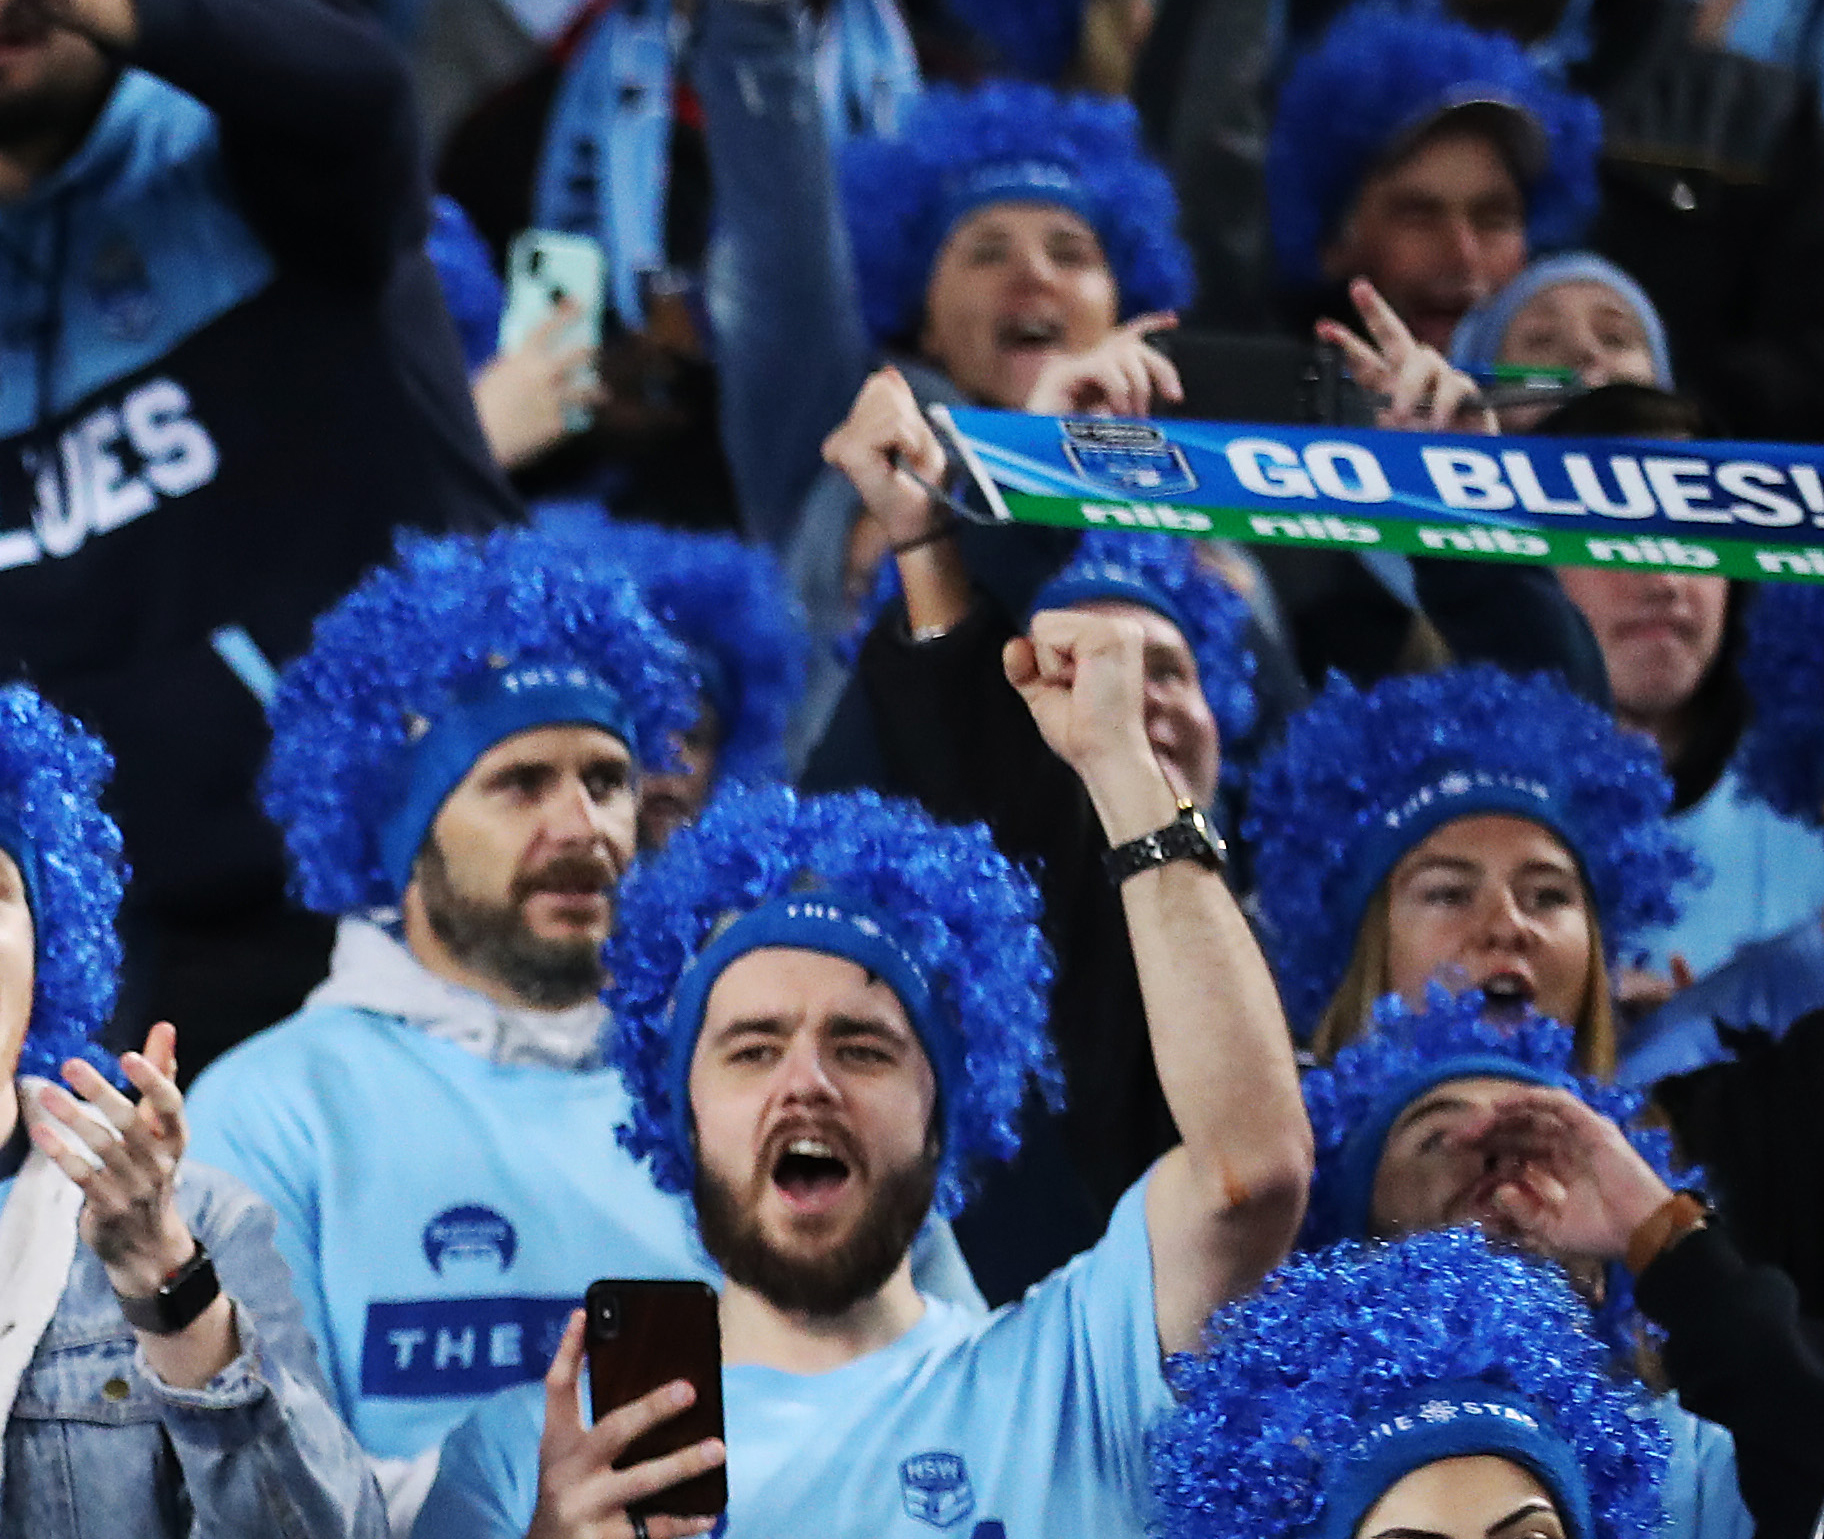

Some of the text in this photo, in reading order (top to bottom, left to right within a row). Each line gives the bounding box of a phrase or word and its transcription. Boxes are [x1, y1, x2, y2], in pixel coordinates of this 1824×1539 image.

[1225, 437, 1824, 529] GO BLUES!
[1081, 503, 1824, 576] nib nib nib nib ni
[787, 902, 842, 923] THE
[386, 1322, 523, 1370] THE
[905, 1457, 961, 1482] NSW
